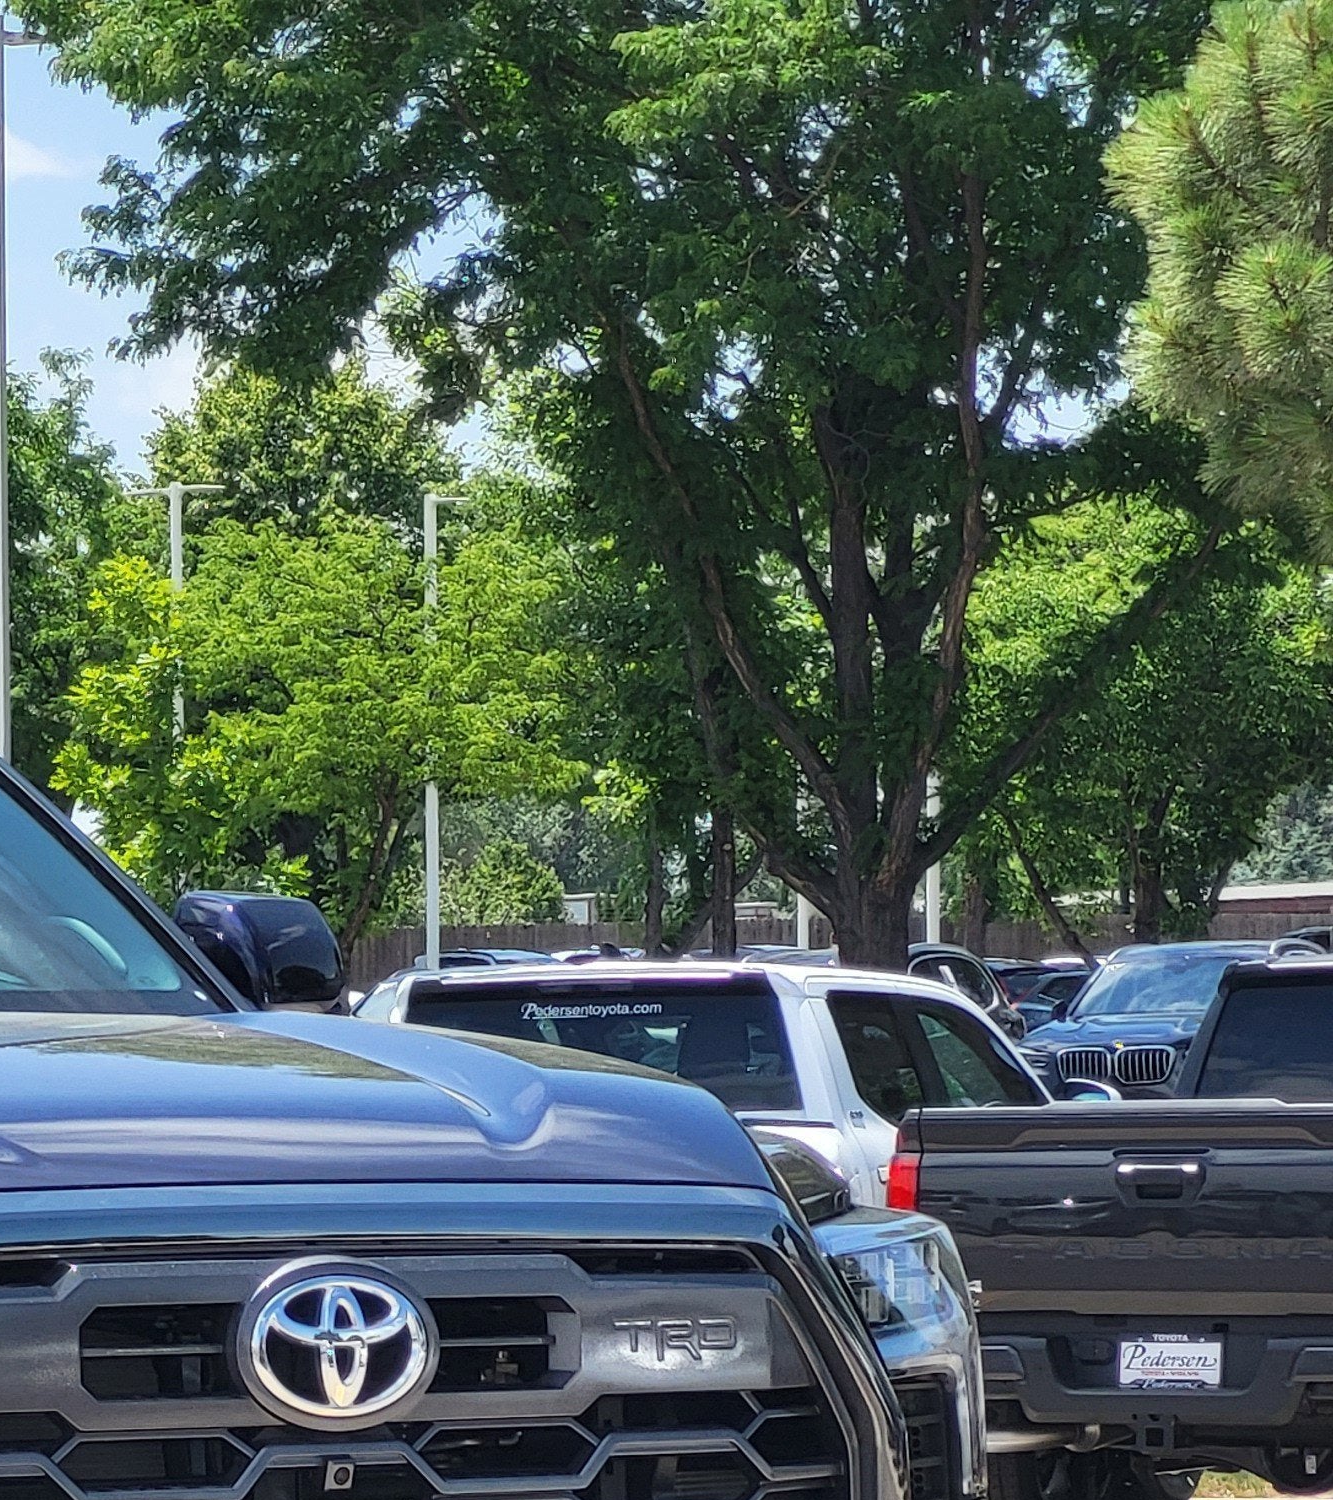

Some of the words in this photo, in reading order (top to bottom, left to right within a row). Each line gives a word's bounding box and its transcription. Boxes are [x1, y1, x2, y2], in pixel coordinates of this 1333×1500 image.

[521, 1003, 662, 1019] Pedersentoyota.com
[613, 1316, 738, 1361] TRD
[1152, 1334, 1189, 1342] TOYOTA
[1123, 1344, 1217, 1369] Pedersen
